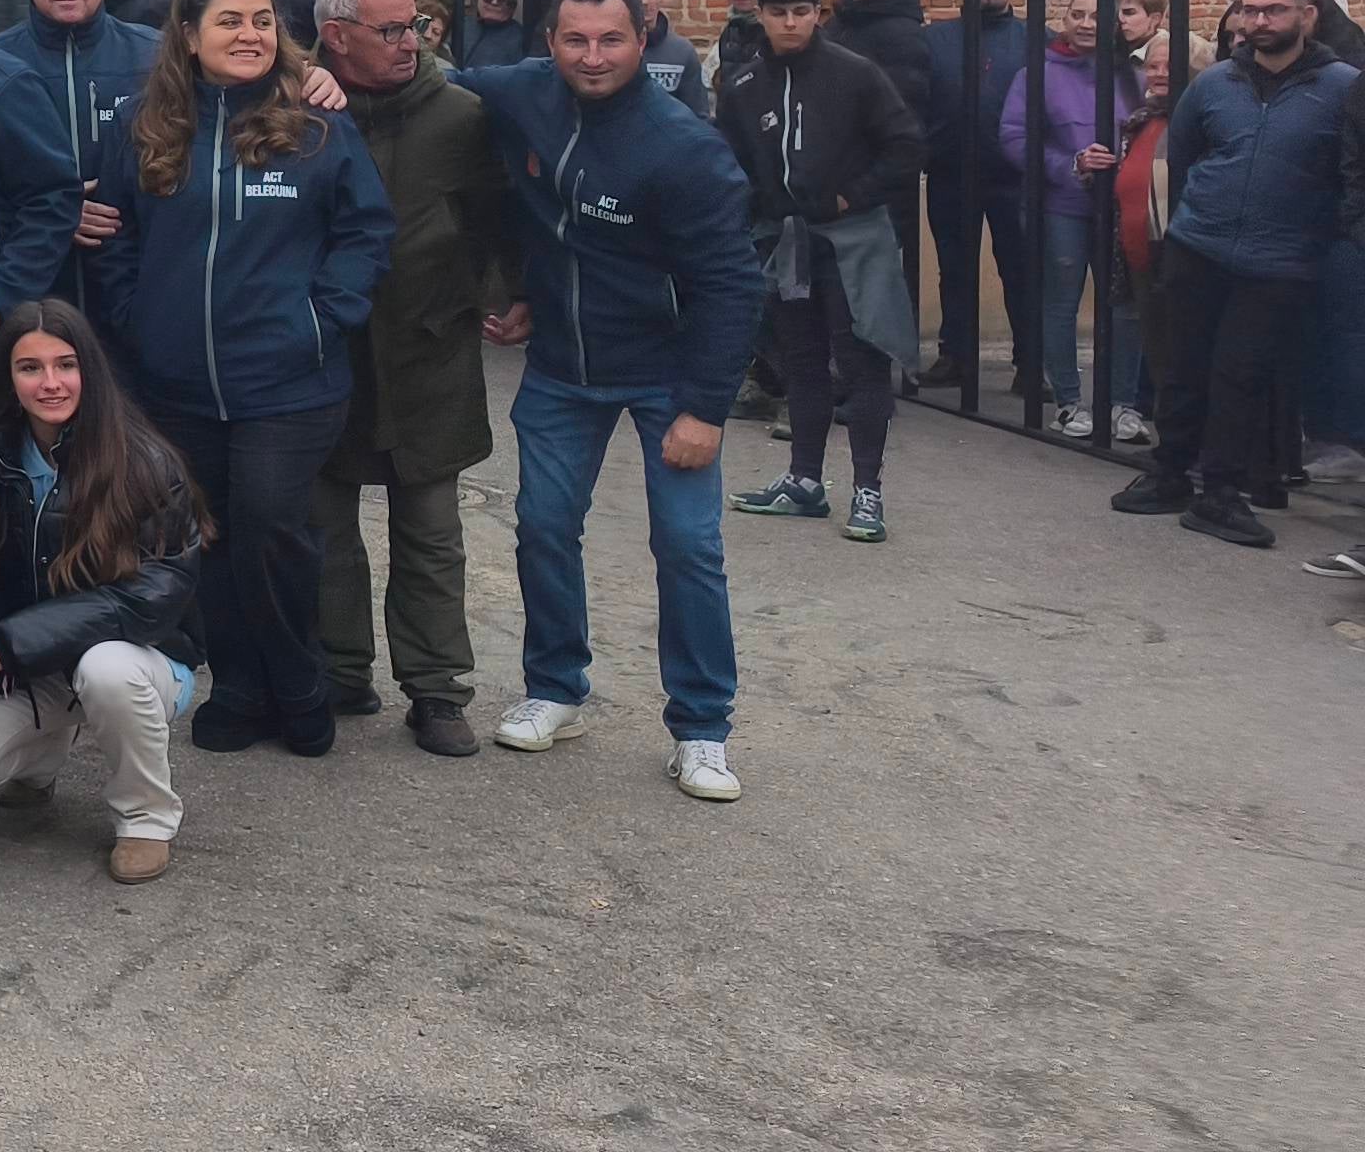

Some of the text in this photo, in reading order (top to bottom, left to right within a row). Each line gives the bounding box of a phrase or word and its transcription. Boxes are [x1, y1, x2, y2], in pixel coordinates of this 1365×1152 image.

[263, 171, 284, 184] ACT
[245, 184, 298, 199] BELEGUINA
[598, 194, 619, 211] ACT
[581, 202, 634, 225] BELEGUINA
